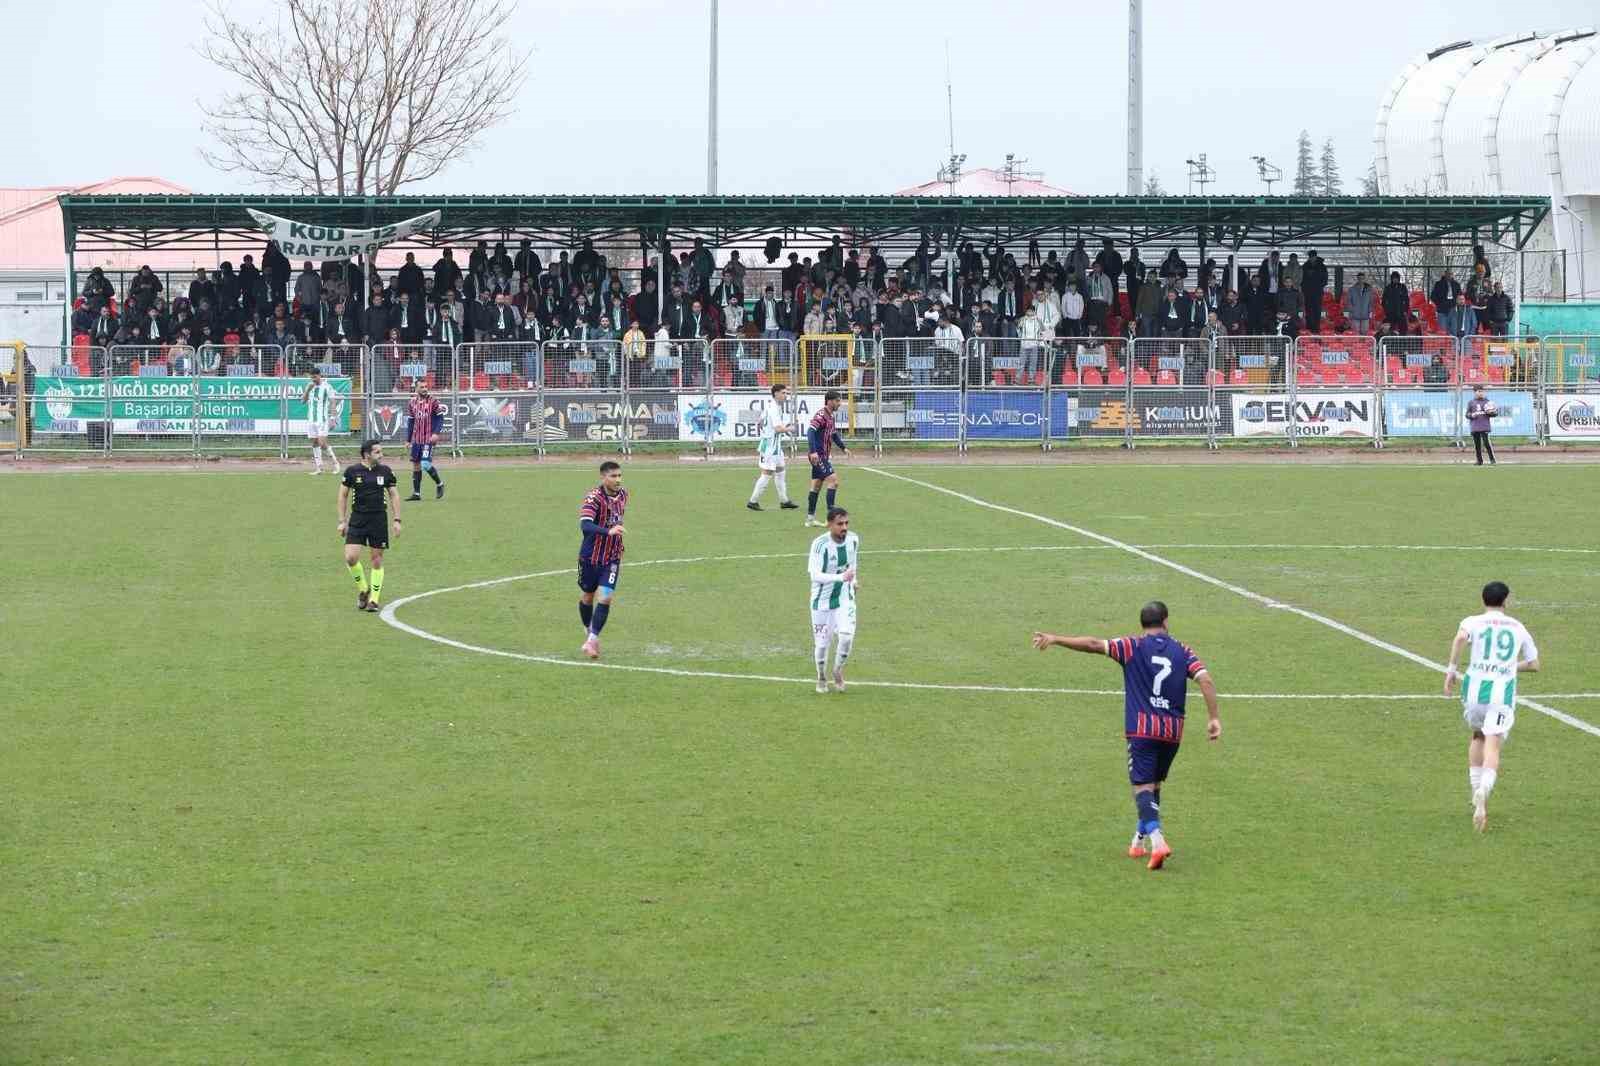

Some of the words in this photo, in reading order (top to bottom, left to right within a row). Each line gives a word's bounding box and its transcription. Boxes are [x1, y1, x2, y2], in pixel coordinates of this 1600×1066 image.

[290, 222, 345, 242] KOD
[370, 226, 397, 240] 12
[79, 385, 95, 397] 12
[99, 380, 148, 397] BNGÖL
[125, 402, 189, 418] Başarılar
[586, 424, 649, 440] GRUP
[1285, 425, 1330, 436] GROUP
[1479, 626, 1516, 661] 19
[1151, 655, 1172, 696] 7
